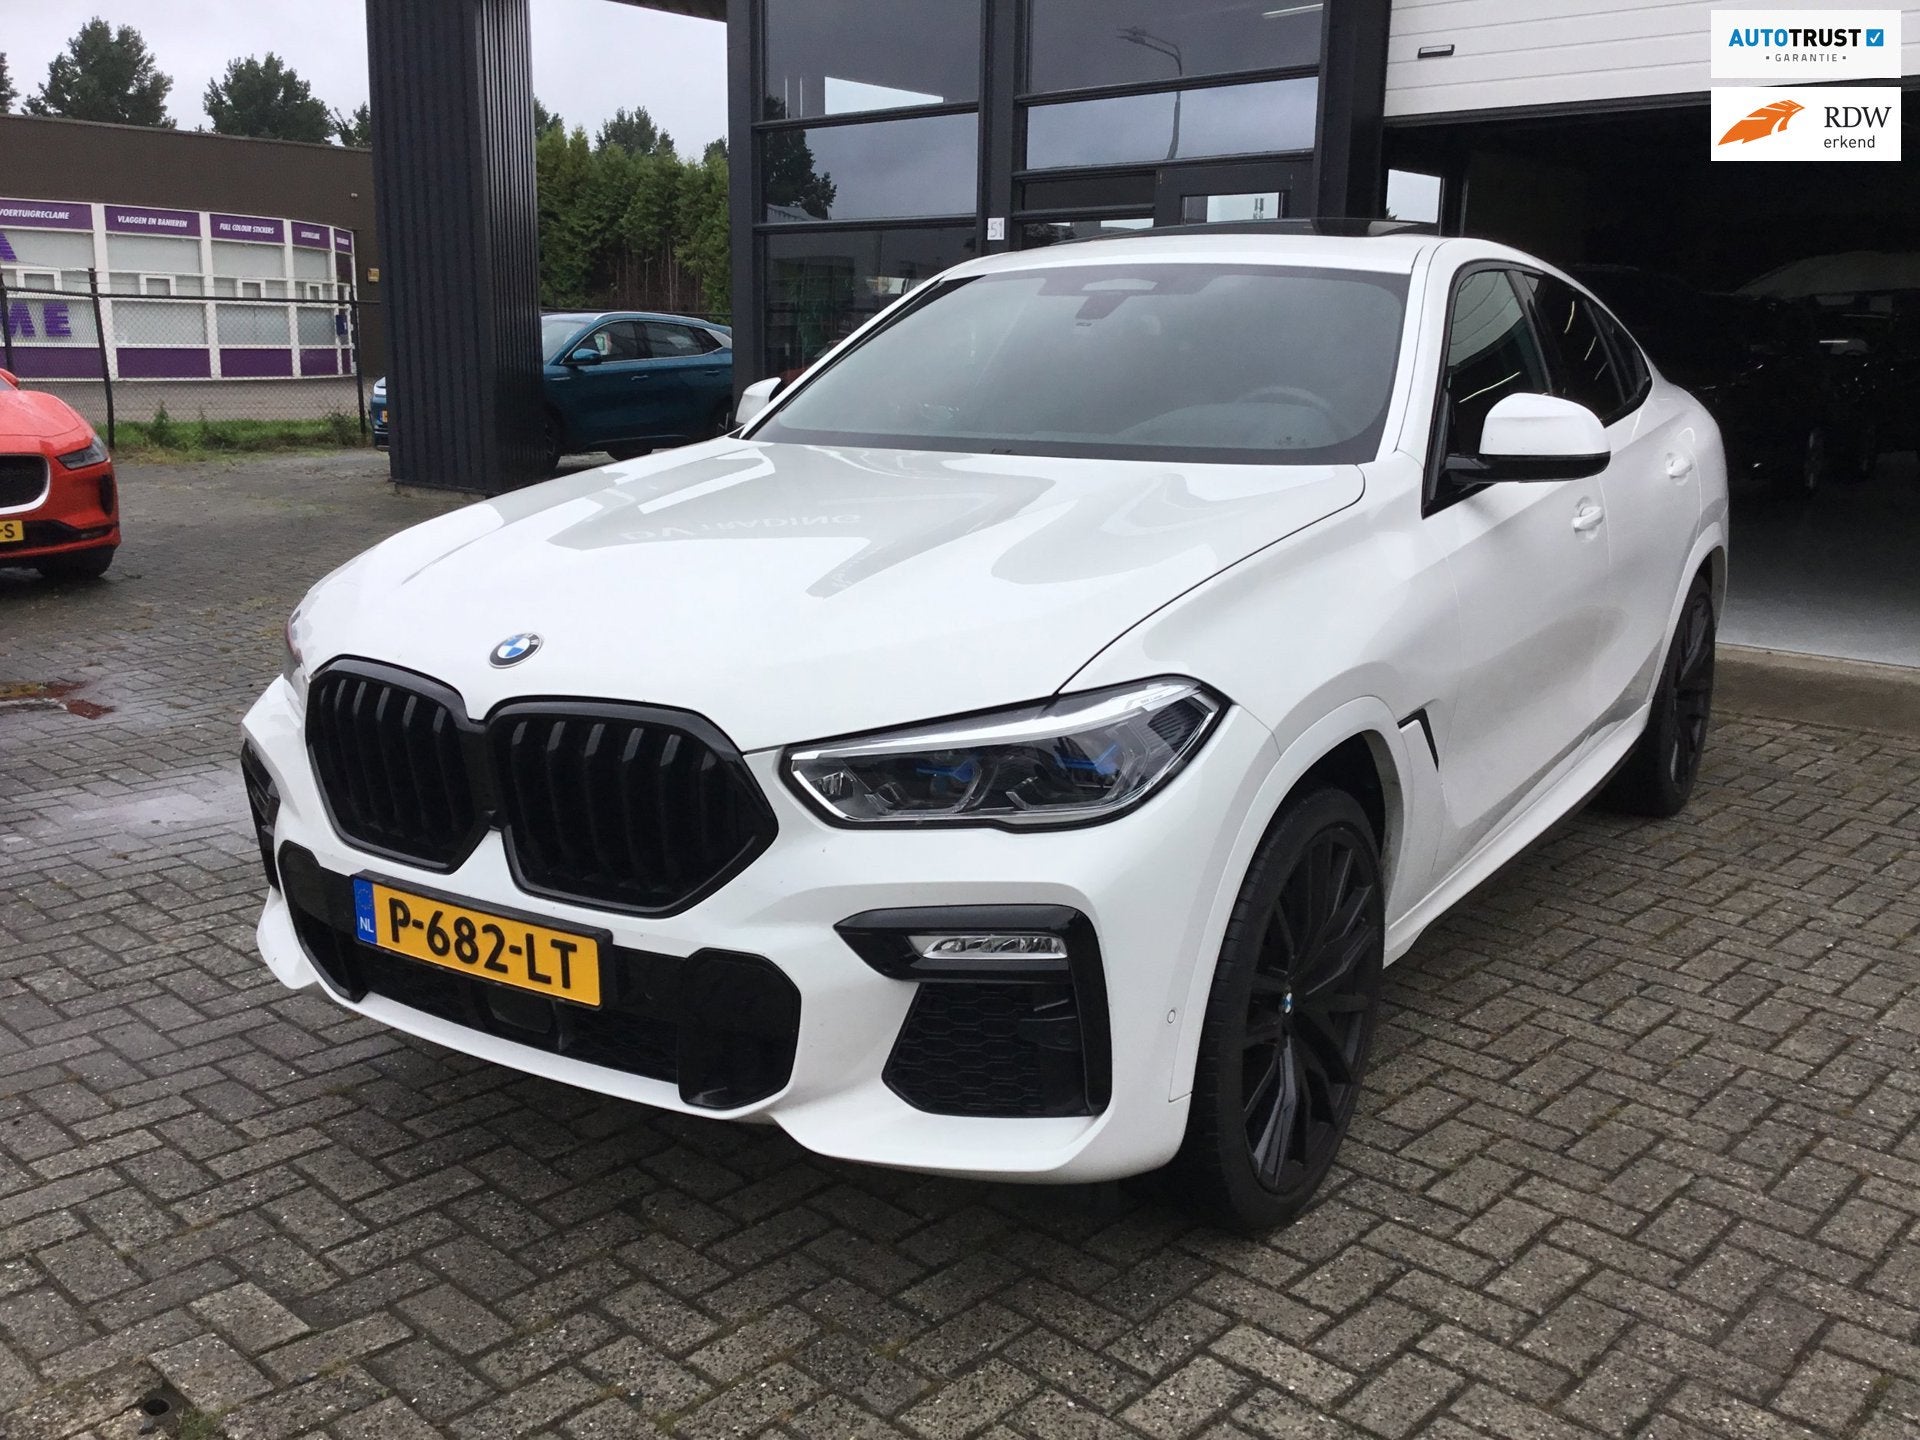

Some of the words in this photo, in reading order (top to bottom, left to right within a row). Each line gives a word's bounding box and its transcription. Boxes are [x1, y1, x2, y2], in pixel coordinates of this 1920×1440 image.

[117, 215, 147, 225] VLAGGEN
[147, 217, 157, 226] EN
[157, 218, 188, 228] BANIEREN
[359, 917, 375, 934] NL
[388, 897, 578, 989] P-682-LT
